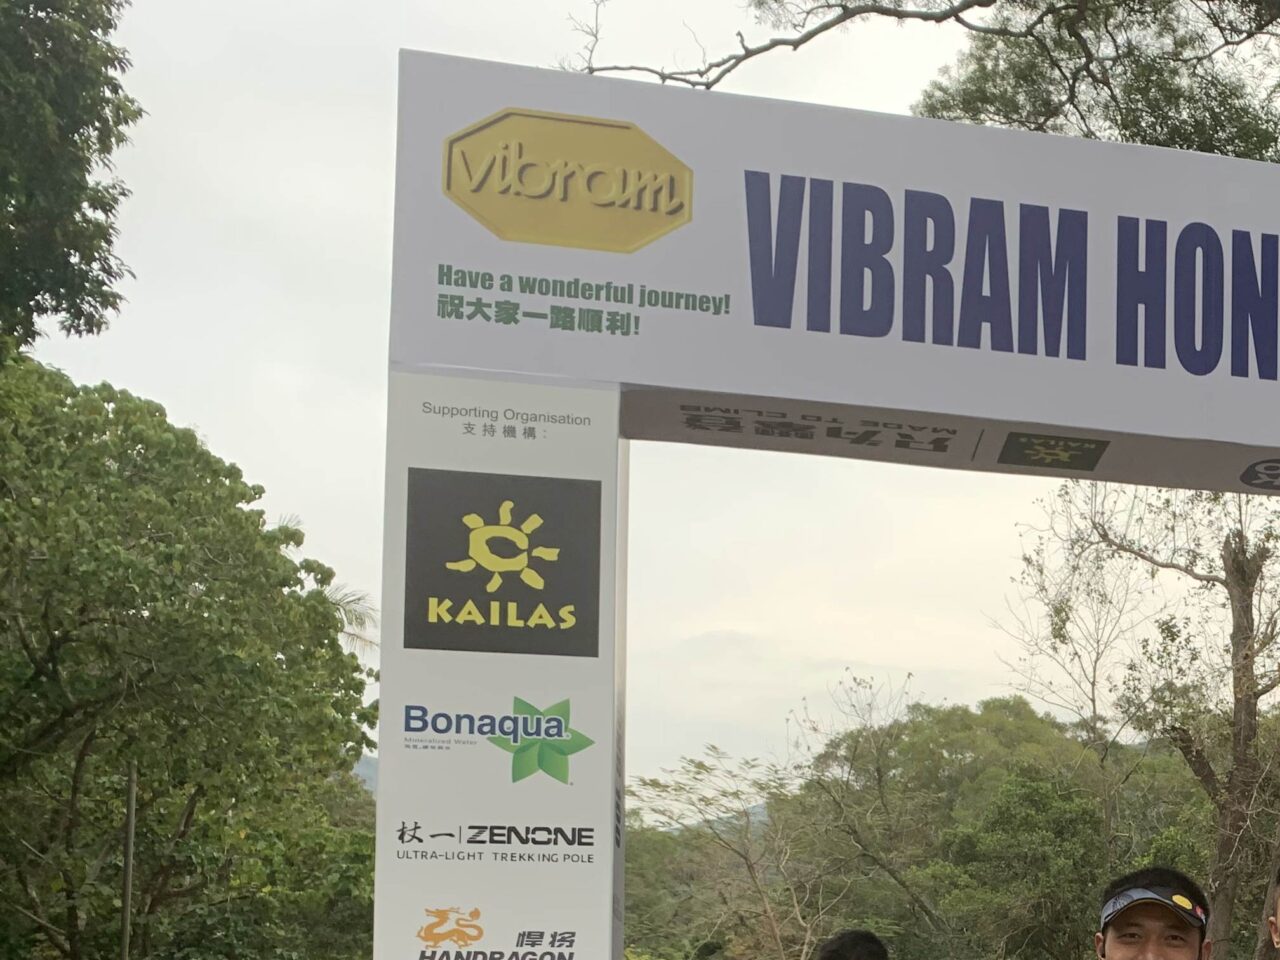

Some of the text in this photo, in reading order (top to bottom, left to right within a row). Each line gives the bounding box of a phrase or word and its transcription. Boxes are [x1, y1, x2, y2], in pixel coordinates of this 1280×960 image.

[744, 170, 1088, 360] VIBRAM
[437, 264, 730, 315] Have a wonderful journey!
[437, 293, 640, 336] 祝大家一路順利!
[422, 401, 591, 427] Supporting Organisation
[427, 596, 577, 630] KAILAS
[404, 704, 564, 744] Bonaqua
[466, 825, 595, 847] ZENONE
[397, 850, 594, 864] ULTRA-LIGHT TREKKING POLE
